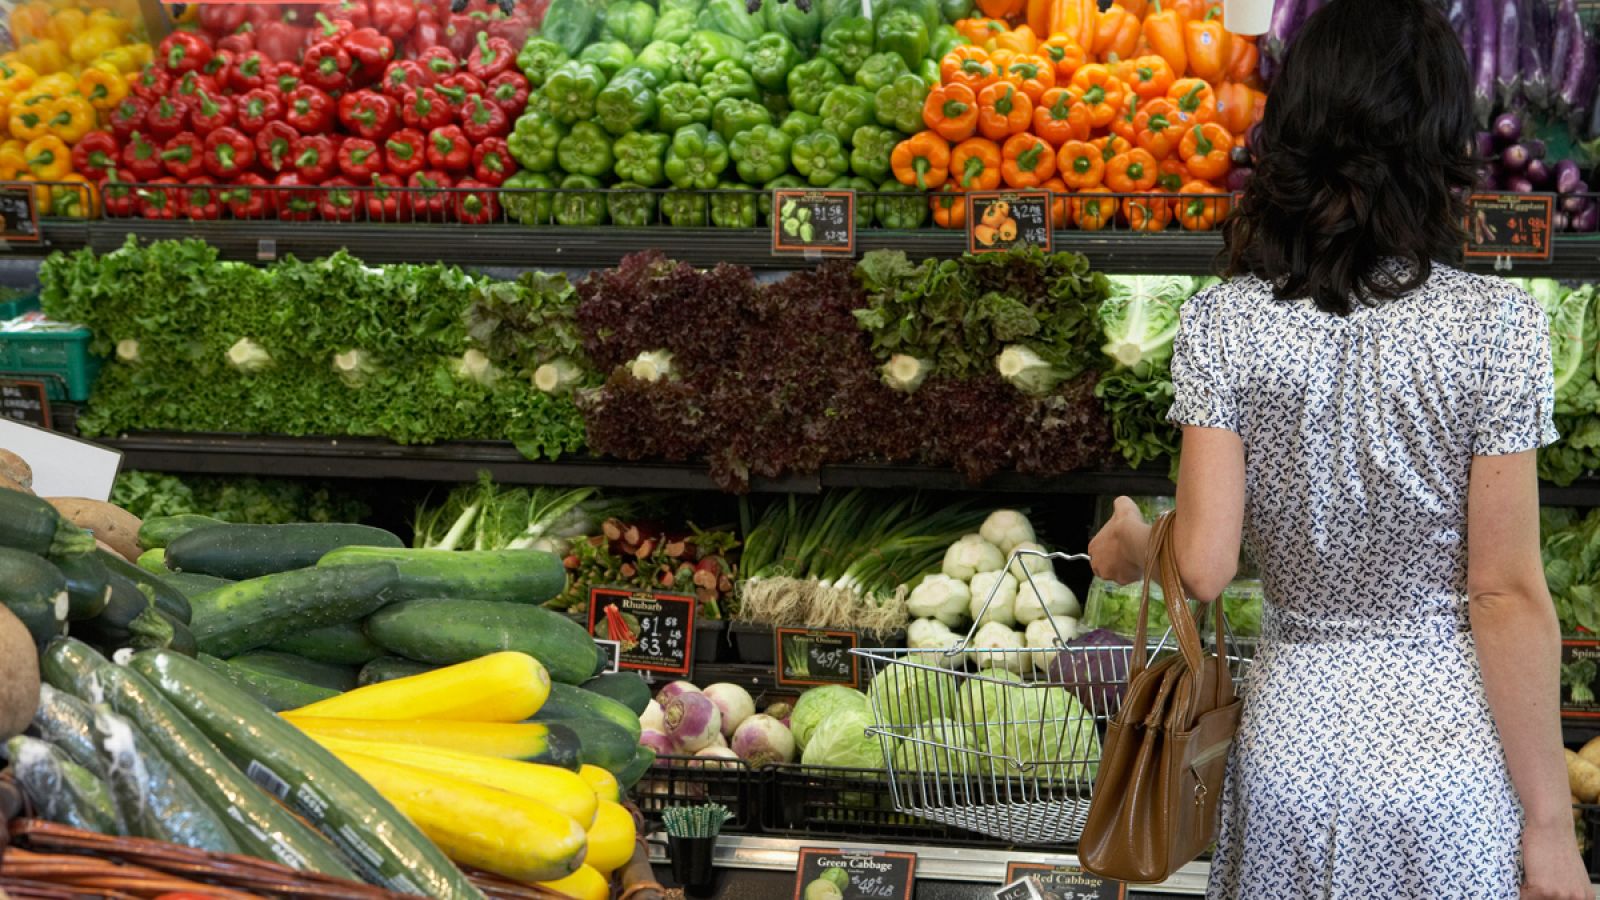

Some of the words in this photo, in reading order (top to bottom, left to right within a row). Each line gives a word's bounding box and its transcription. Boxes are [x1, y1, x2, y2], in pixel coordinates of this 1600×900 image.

[622, 599, 662, 612] Rhubarb
[817, 857, 847, 868] Green
[849, 859, 893, 872] Cabbage
[1032, 873, 1053, 883] Red
[1056, 875, 1103, 888] Cabbage
